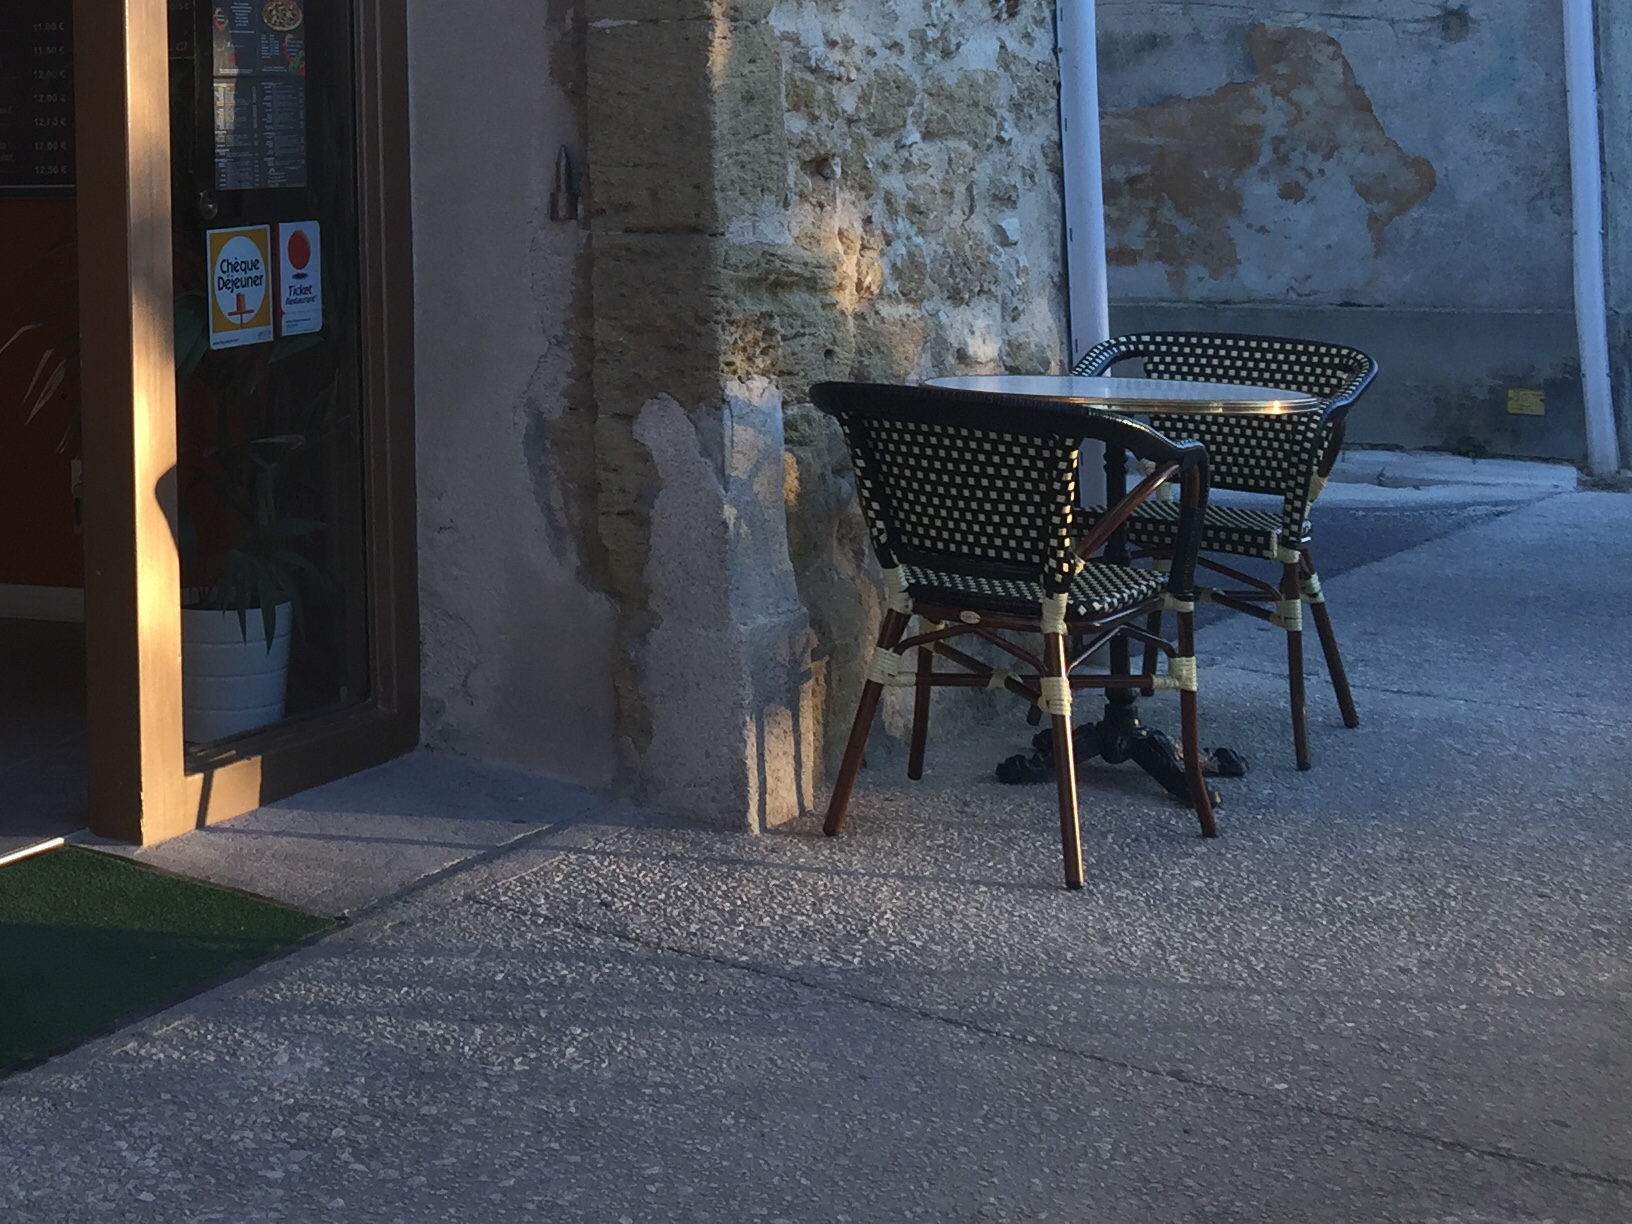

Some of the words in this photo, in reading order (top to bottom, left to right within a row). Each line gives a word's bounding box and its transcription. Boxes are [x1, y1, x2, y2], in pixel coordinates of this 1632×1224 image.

[220, 257, 259, 274] Chèque
[218, 274, 263, 293] Déjeuner
[288, 284, 313, 297] Ticket
